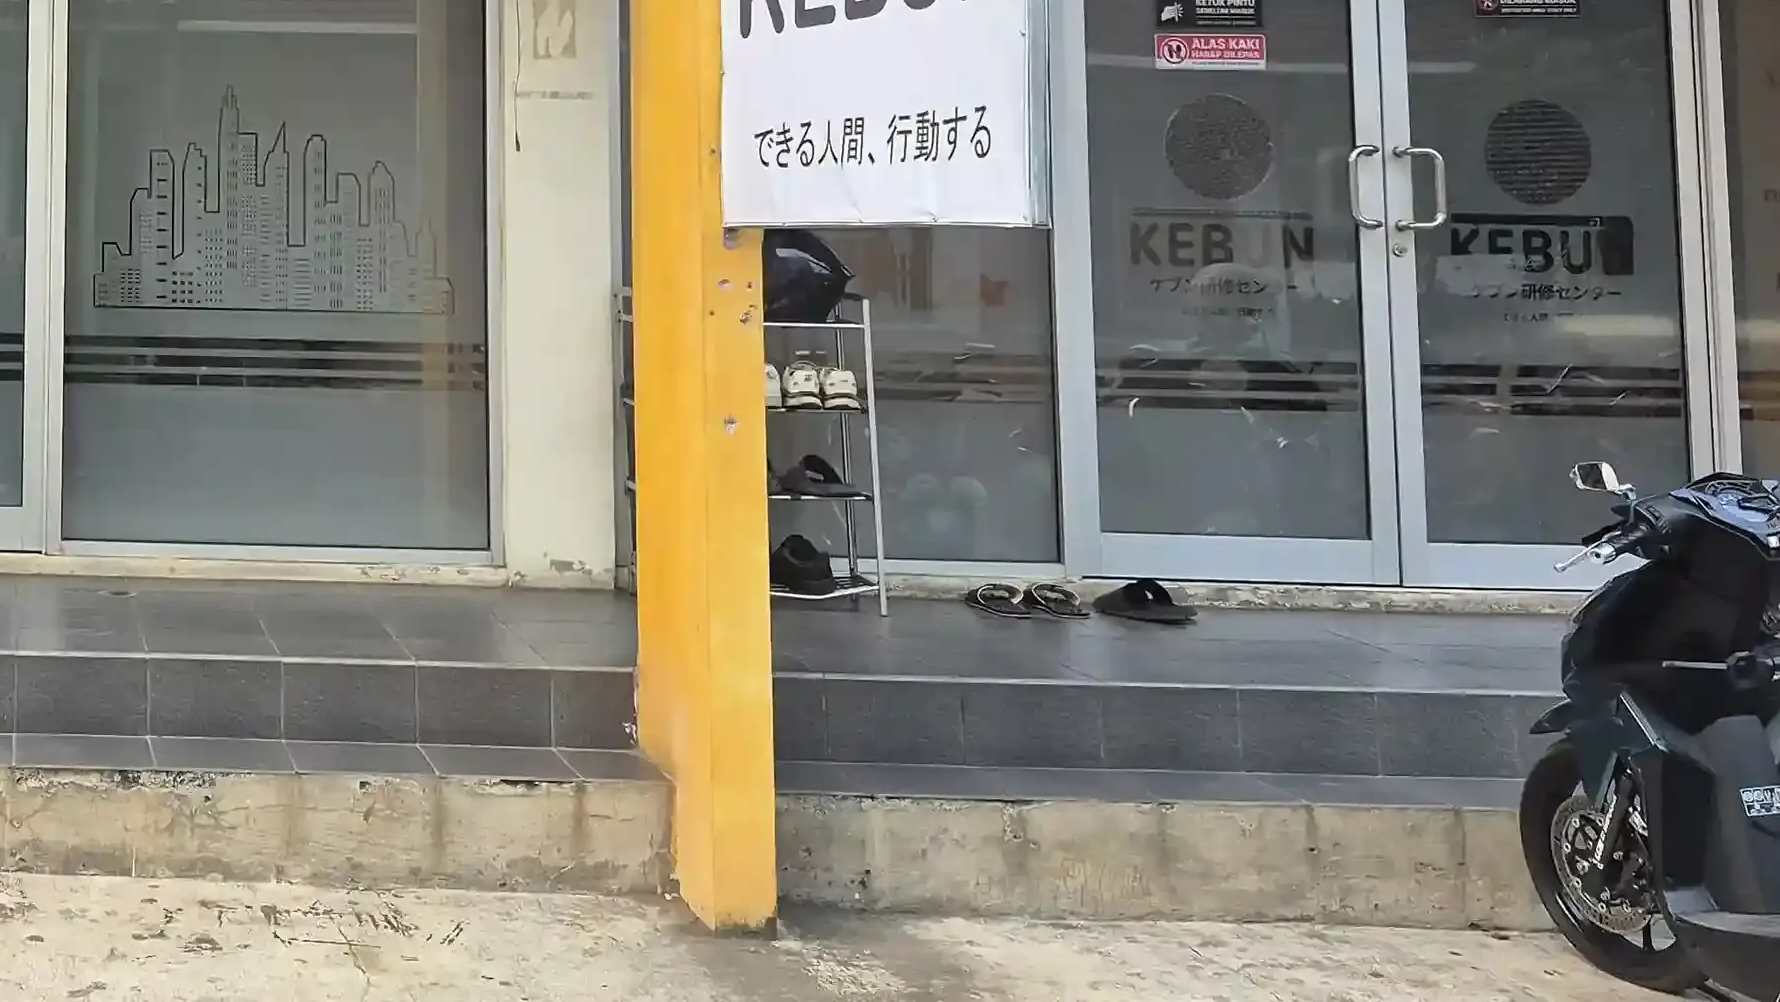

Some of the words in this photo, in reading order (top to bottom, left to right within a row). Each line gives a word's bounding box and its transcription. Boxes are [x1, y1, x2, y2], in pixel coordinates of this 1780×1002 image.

[1191, 37, 1226, 50] ALAS
[1228, 37, 1260, 50] KAKI
[753, 104, 993, 170] できる人間、行動する
